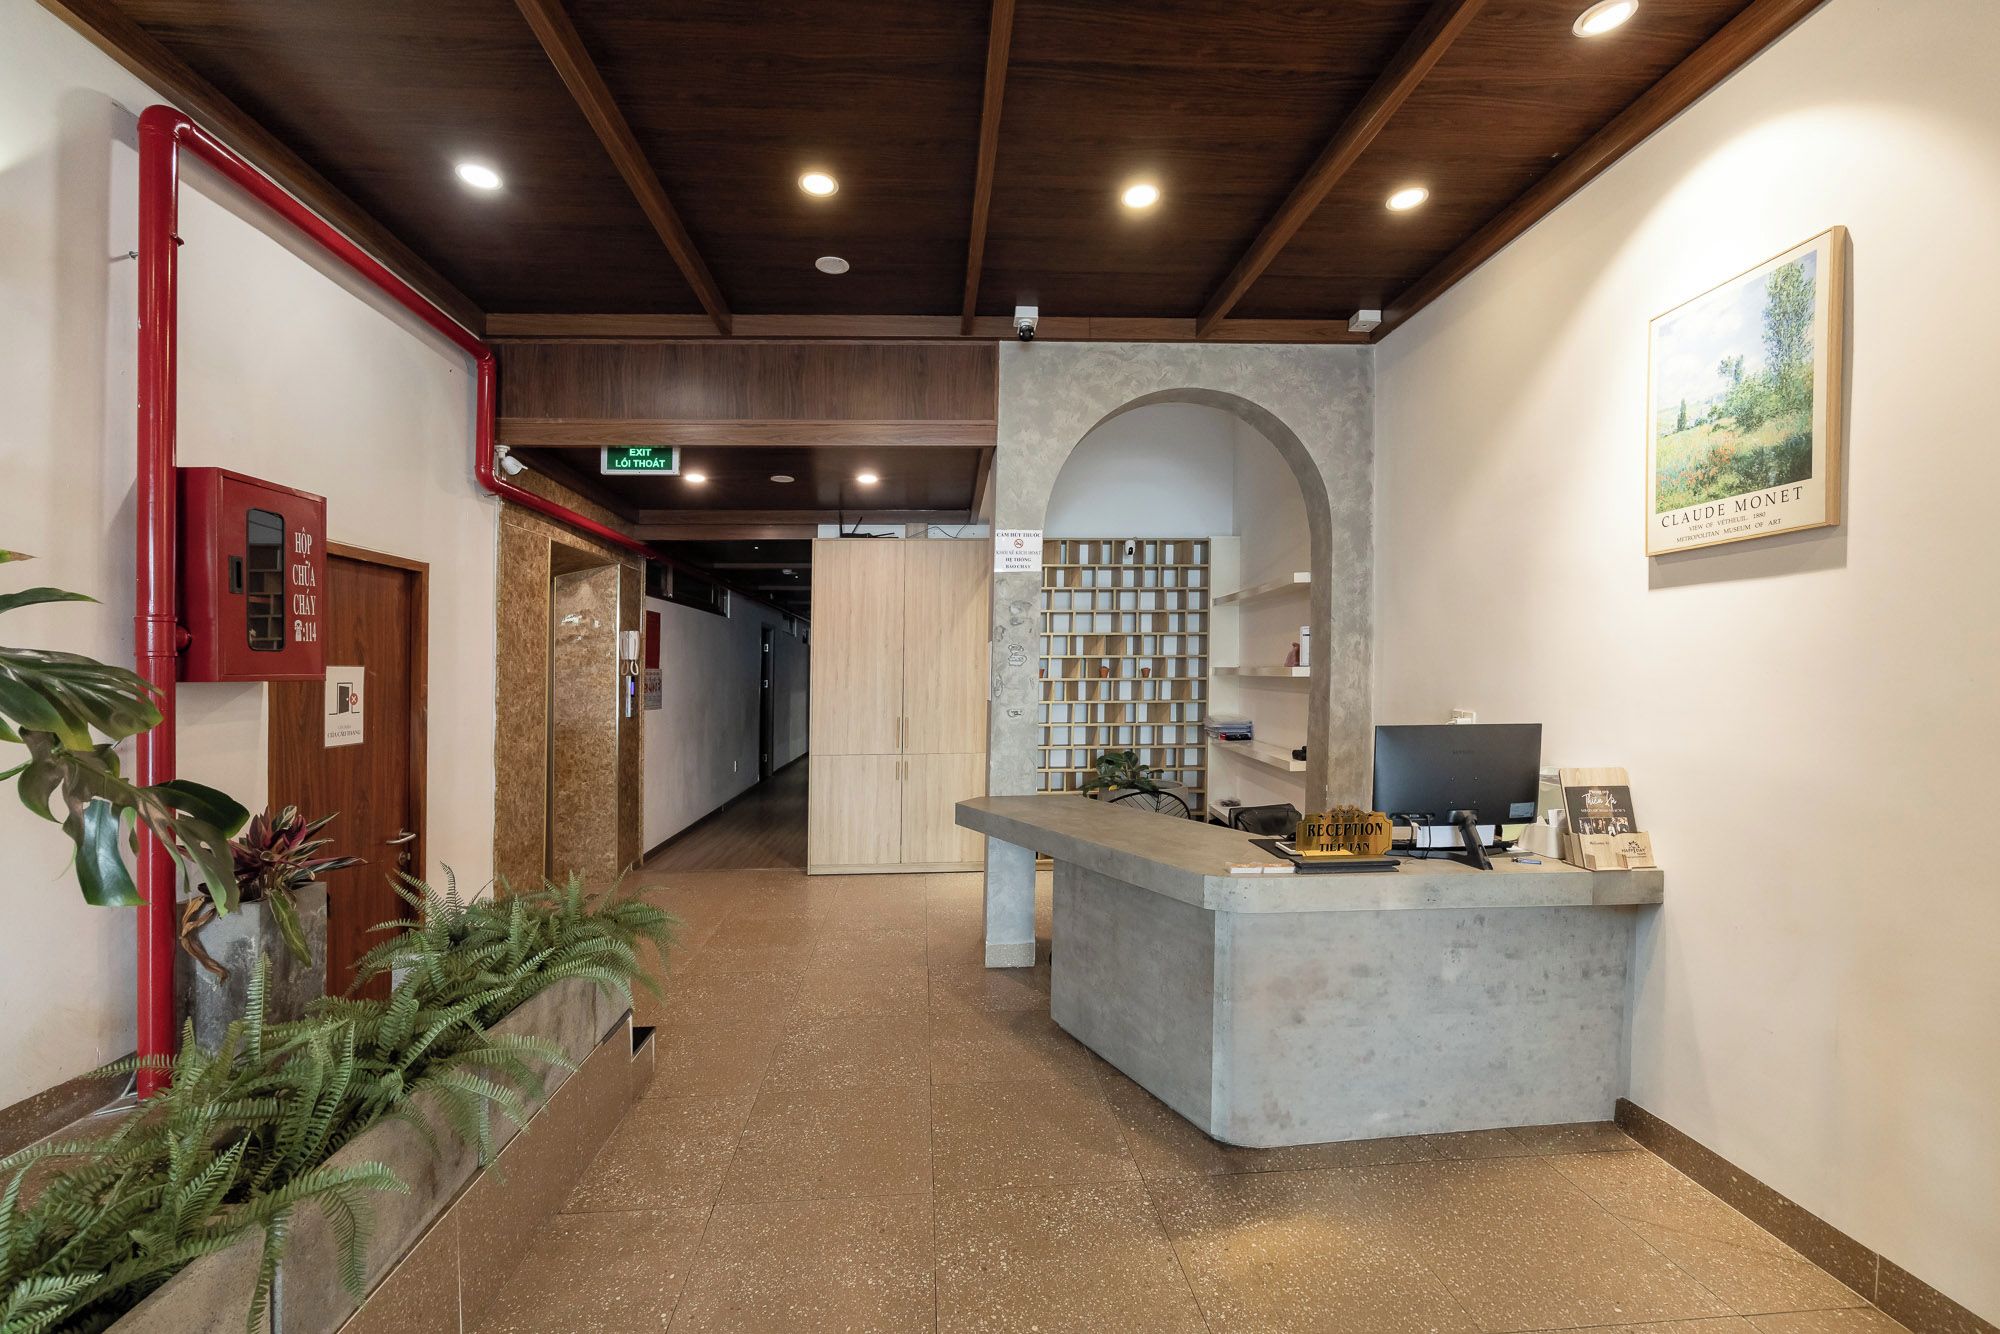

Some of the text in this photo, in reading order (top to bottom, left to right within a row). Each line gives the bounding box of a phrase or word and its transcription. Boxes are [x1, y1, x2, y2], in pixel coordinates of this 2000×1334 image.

[615, 457, 665, 467] LỐI THOÁT
[629, 448, 652, 456] EXIT
[1661, 486, 1803, 527] CLAUDE MONET
[1676, 518, 1782, 543] METROPOLITAN MUSEUM OF ART
[1689, 521, 1703, 531] VIEW
[1705, 520, 1714, 528] OF
[1753, 511, 1766, 519] 1880
[294, 526, 313, 558] HỘP
[292, 560, 316, 586] CHỮA
[293, 588, 316, 615] CHÁY
[1307, 822, 1383, 837] RECEPTION
[1319, 838, 1344, 852] TIẾP
